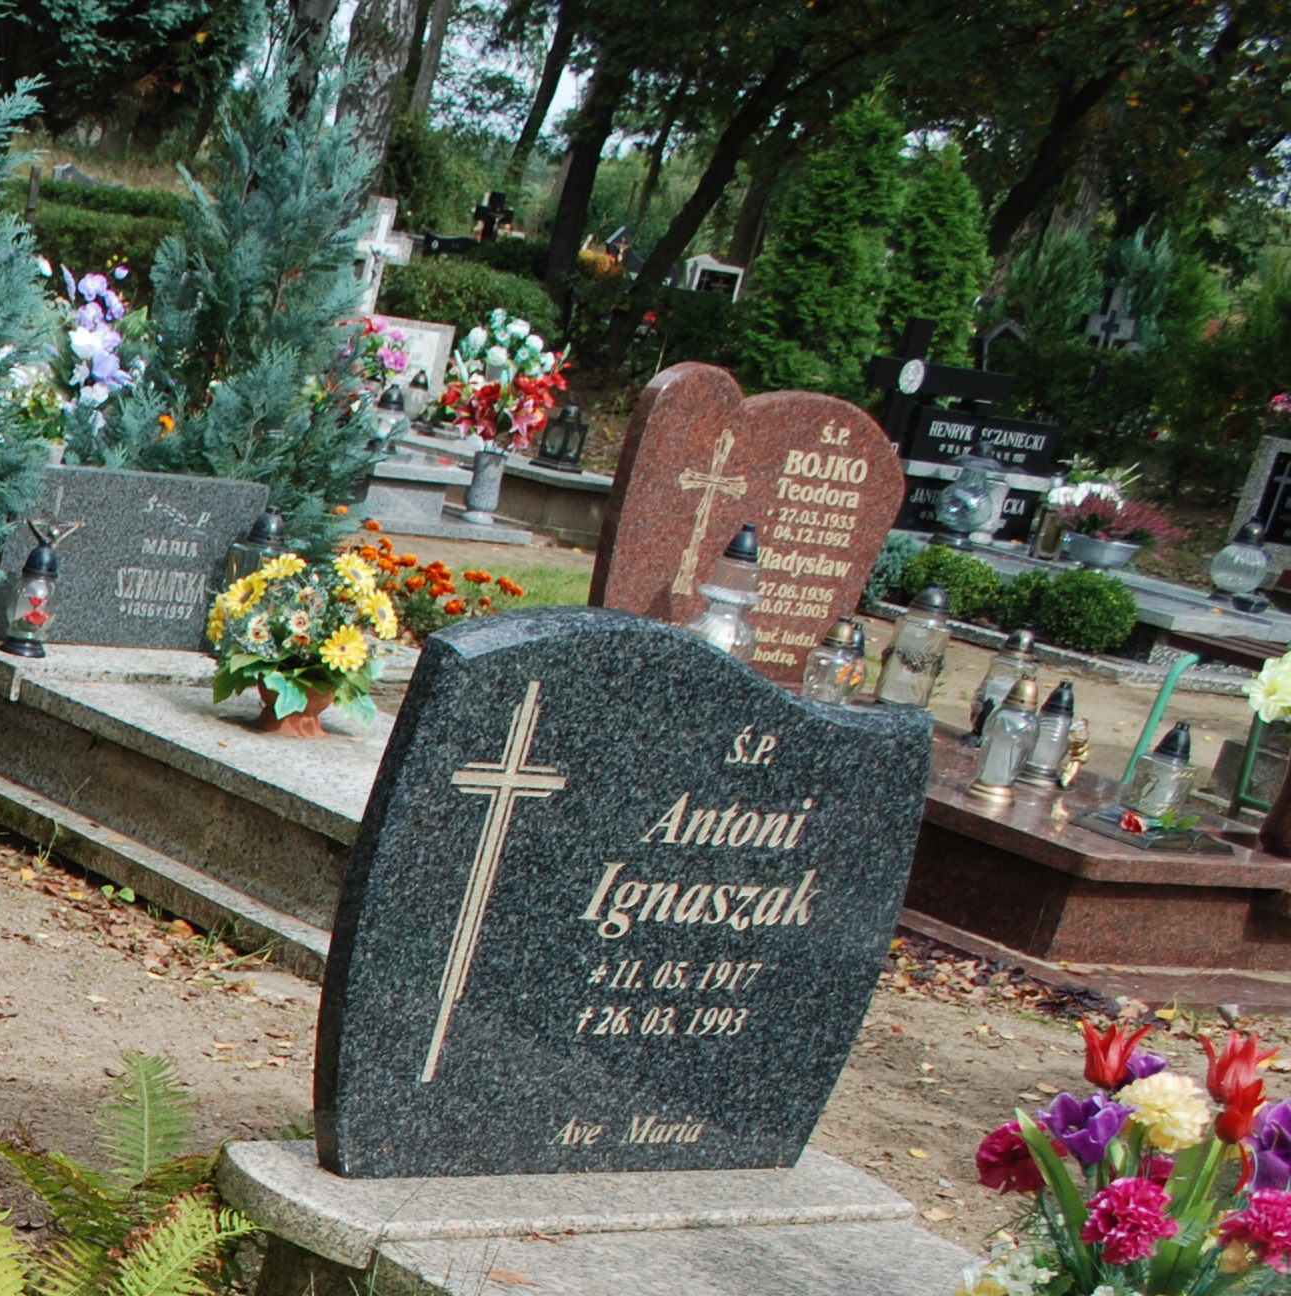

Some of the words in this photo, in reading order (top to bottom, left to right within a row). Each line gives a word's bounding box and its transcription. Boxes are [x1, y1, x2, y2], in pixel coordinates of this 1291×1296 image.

[928, 420, 975, 442] HENRYK
[783, 449, 868, 485] BOJKO
[776, 477, 860, 509] Teodora
[141, 537, 199, 558] MARIA
[639, 791, 814, 850] Antoni
[576, 861, 823, 939] Ignaszak
[549, 1115, 604, 1145] Ave
[620, 1114, 707, 1145] Maria
